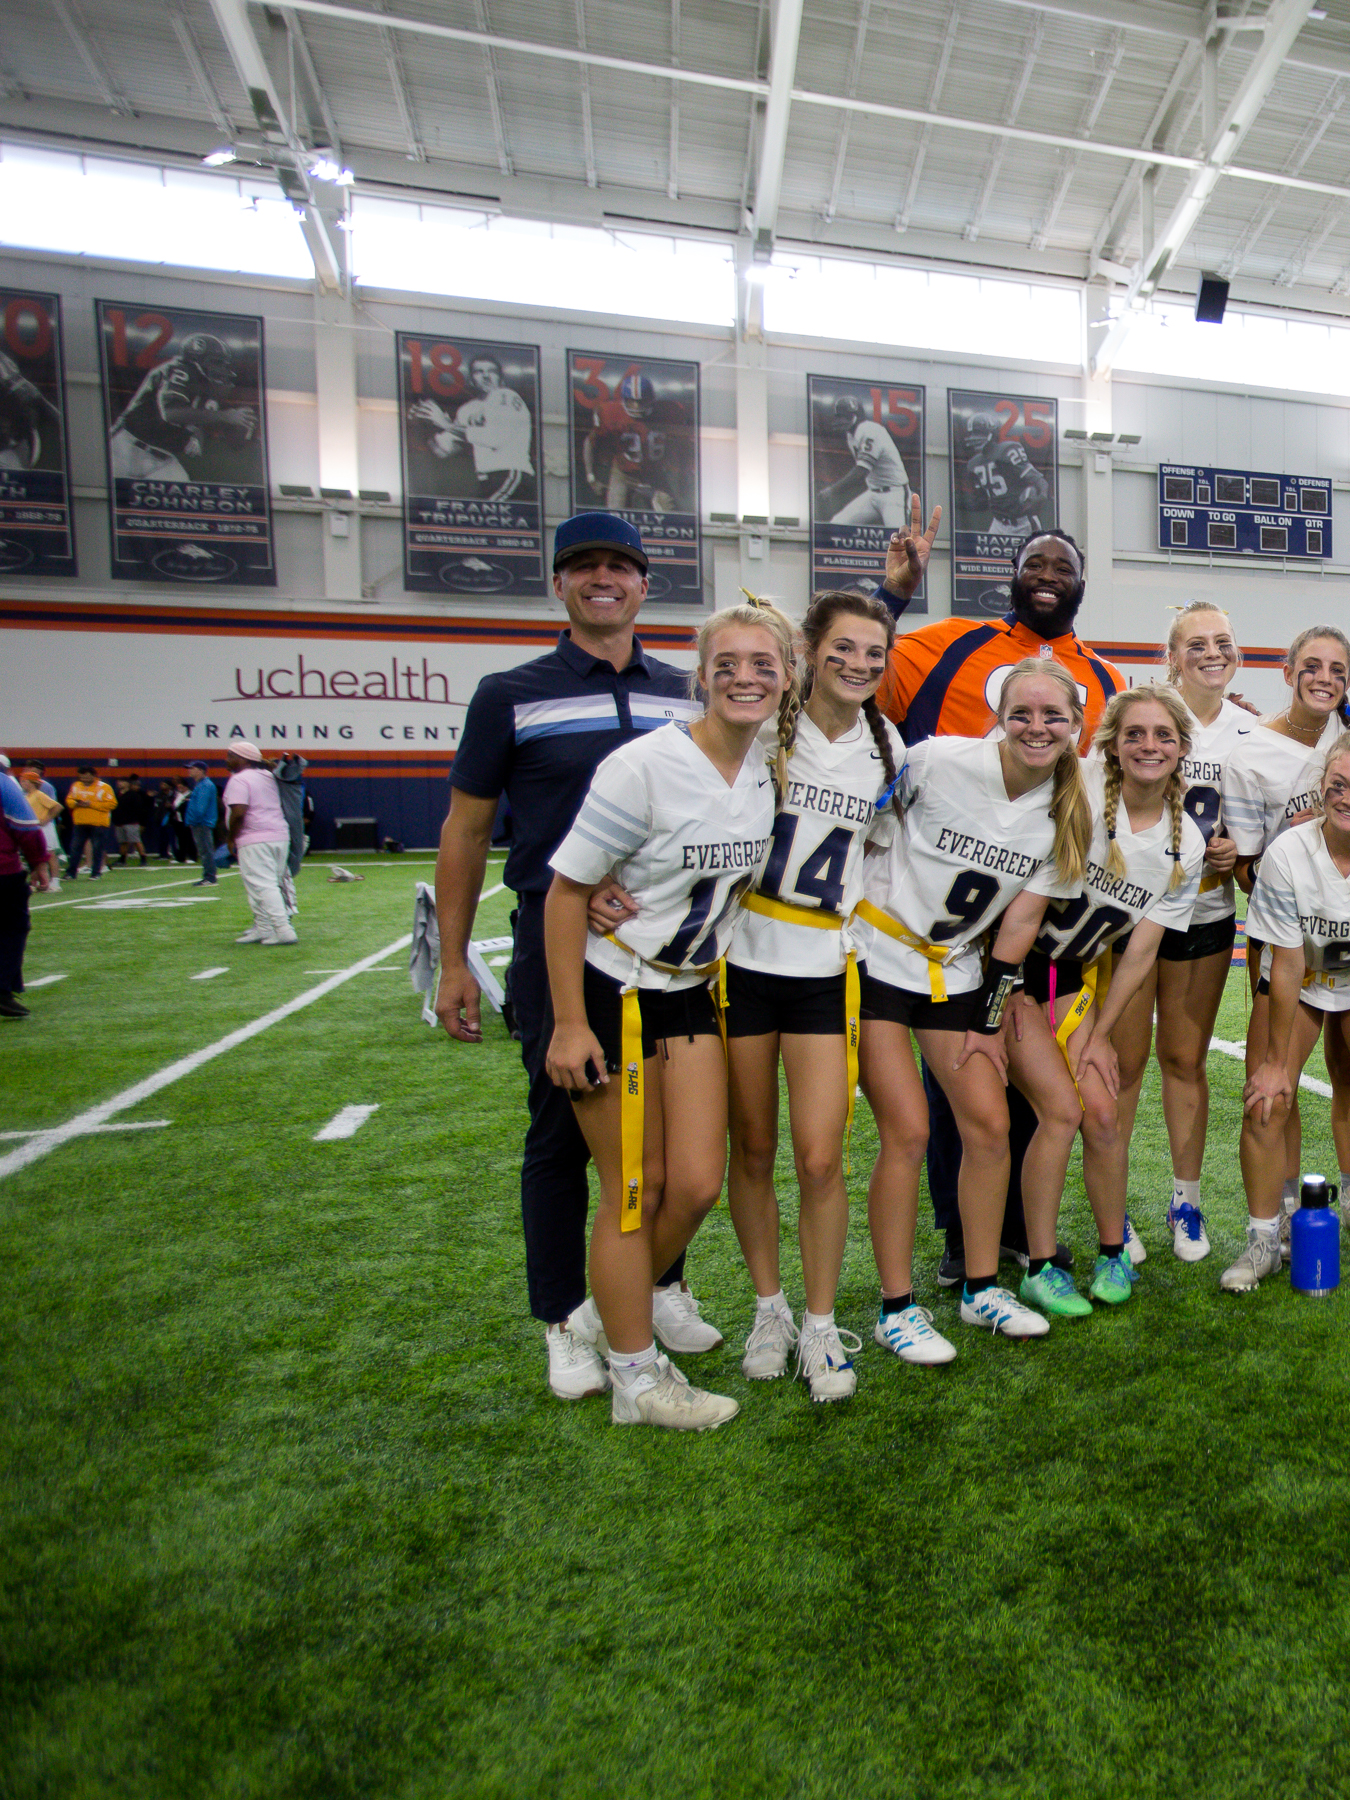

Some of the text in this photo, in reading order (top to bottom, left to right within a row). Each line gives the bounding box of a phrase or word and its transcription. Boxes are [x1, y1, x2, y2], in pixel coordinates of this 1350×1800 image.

[105, 309, 174, 369] 12
[406, 340, 465, 397] 18
[870, 388, 918, 437] 15
[994, 400, 1052, 448] 25
[1162, 466, 1195, 476] OFFENSE
[131, 482, 250, 499] CHARLEY
[1298, 478, 1330, 488] DEFENSE
[129, 495, 253, 513] JOHNSON
[436, 501, 512, 515] FRANK
[419, 511, 530, 528] TRIPUCKA
[1163, 508, 1195, 519] DOWN
[1208, 511, 1236, 522] TO GO
[1254, 515, 1292, 526] BALL ON
[1305, 519, 1323, 529] QTR
[853, 528, 884, 539] JIM
[977, 535, 1026, 547] HAVE
[831, 537, 890, 550] TURNE
[976, 546, 1018, 557] MOS
[823, 557, 879, 567] PLACEKICKER
[960, 564, 1014, 574] WIDE RECEIVE
[235, 654, 450, 701] uchealth
[182, 724, 460, 740] TRAINING CENT
[787, 781, 876, 826] ERGREEN
[682, 838, 769, 870] EVERGREE
[936, 828, 1043, 879] EVERGREEN
[760, 810, 857, 914] 14
[1086, 860, 1154, 910] ERGREEN
[926, 867, 1002, 943] 9
